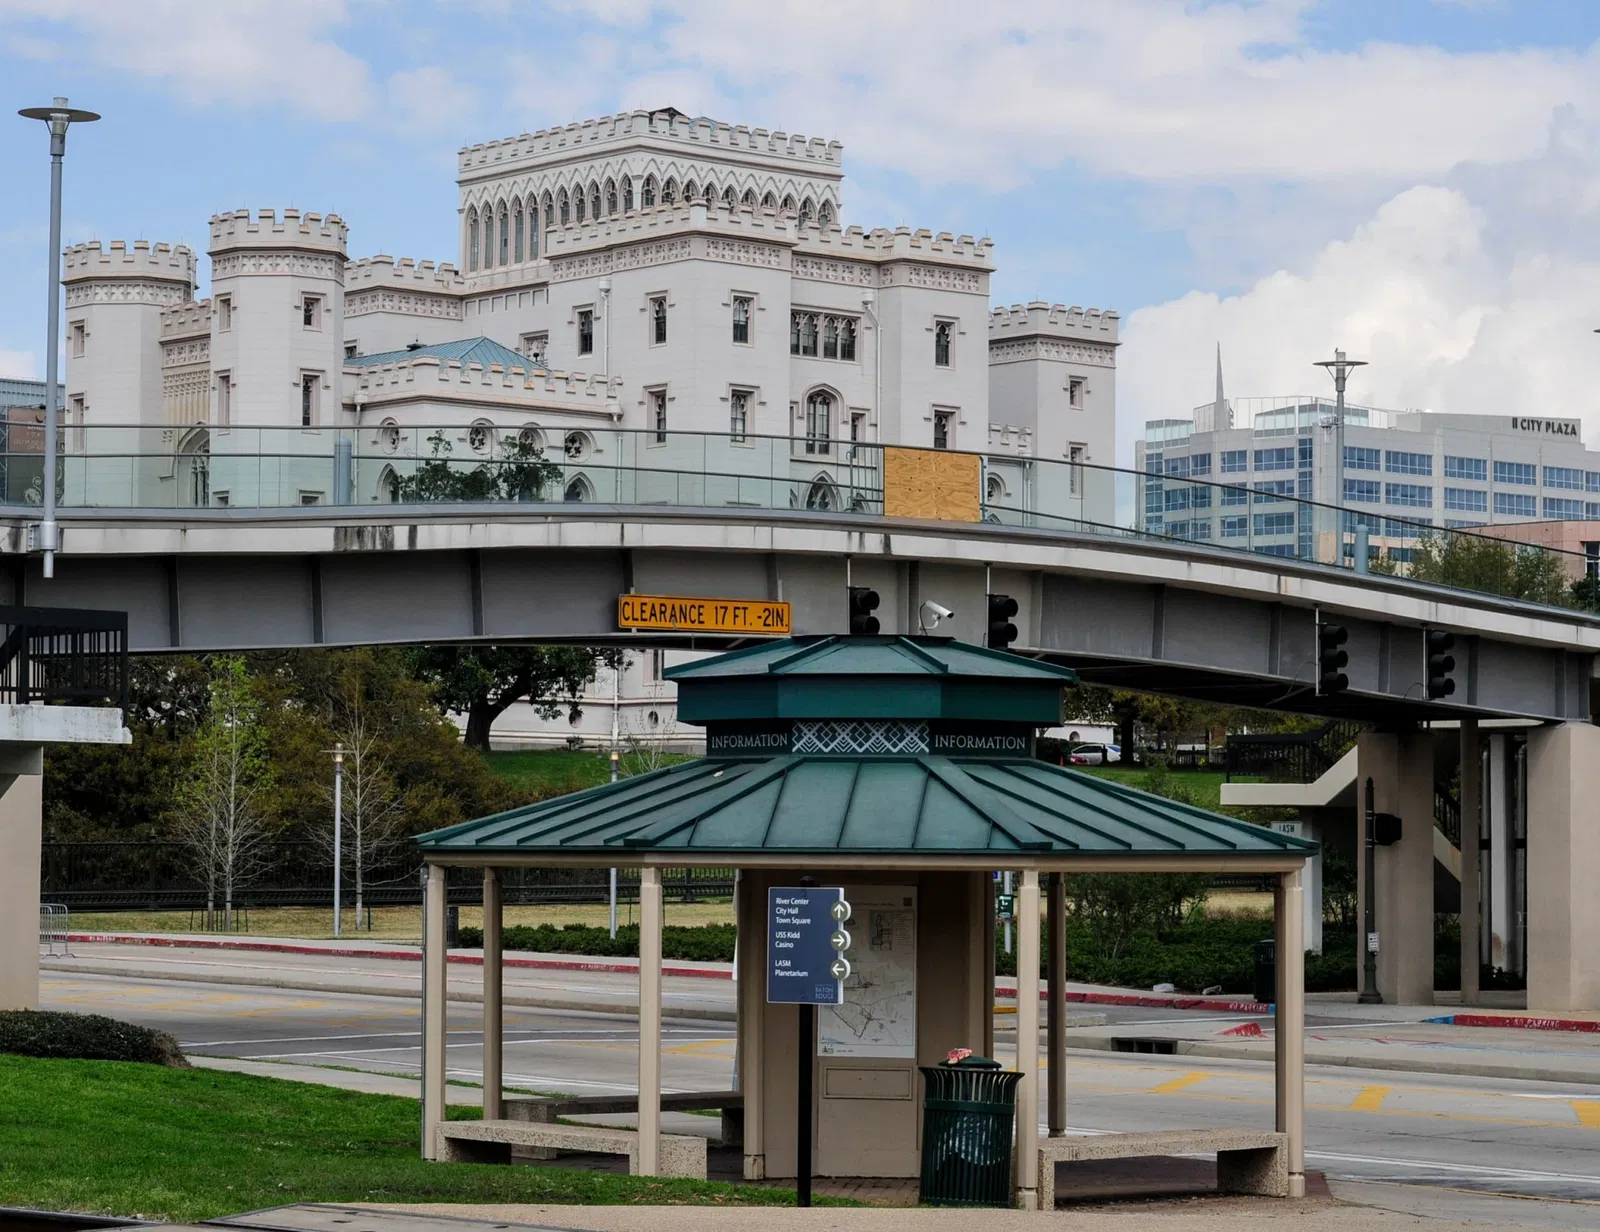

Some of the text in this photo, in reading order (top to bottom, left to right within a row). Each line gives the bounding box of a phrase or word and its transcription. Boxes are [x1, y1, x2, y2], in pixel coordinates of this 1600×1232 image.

[1520, 418, 1542, 432] CITY
[1545, 420, 1577, 436] PLAZA
[621, 601, 705, 625] CLEARANCE
[714, 605, 729, 625] 17
[733, 606, 753, 626] FT.
[711, 733, 788, 749] INFORMATION
[934, 734, 1026, 750] INFORMATION
[775, 897, 810, 906] River Center
[775, 906, 799, 916] City Hall
[775, 916, 812, 926] Town Square
[775, 931, 801, 939] USS Kidd
[774, 940, 795, 949] Casino
[774, 959, 792, 967] LASM
[774, 968, 809, 977] Planetarium
